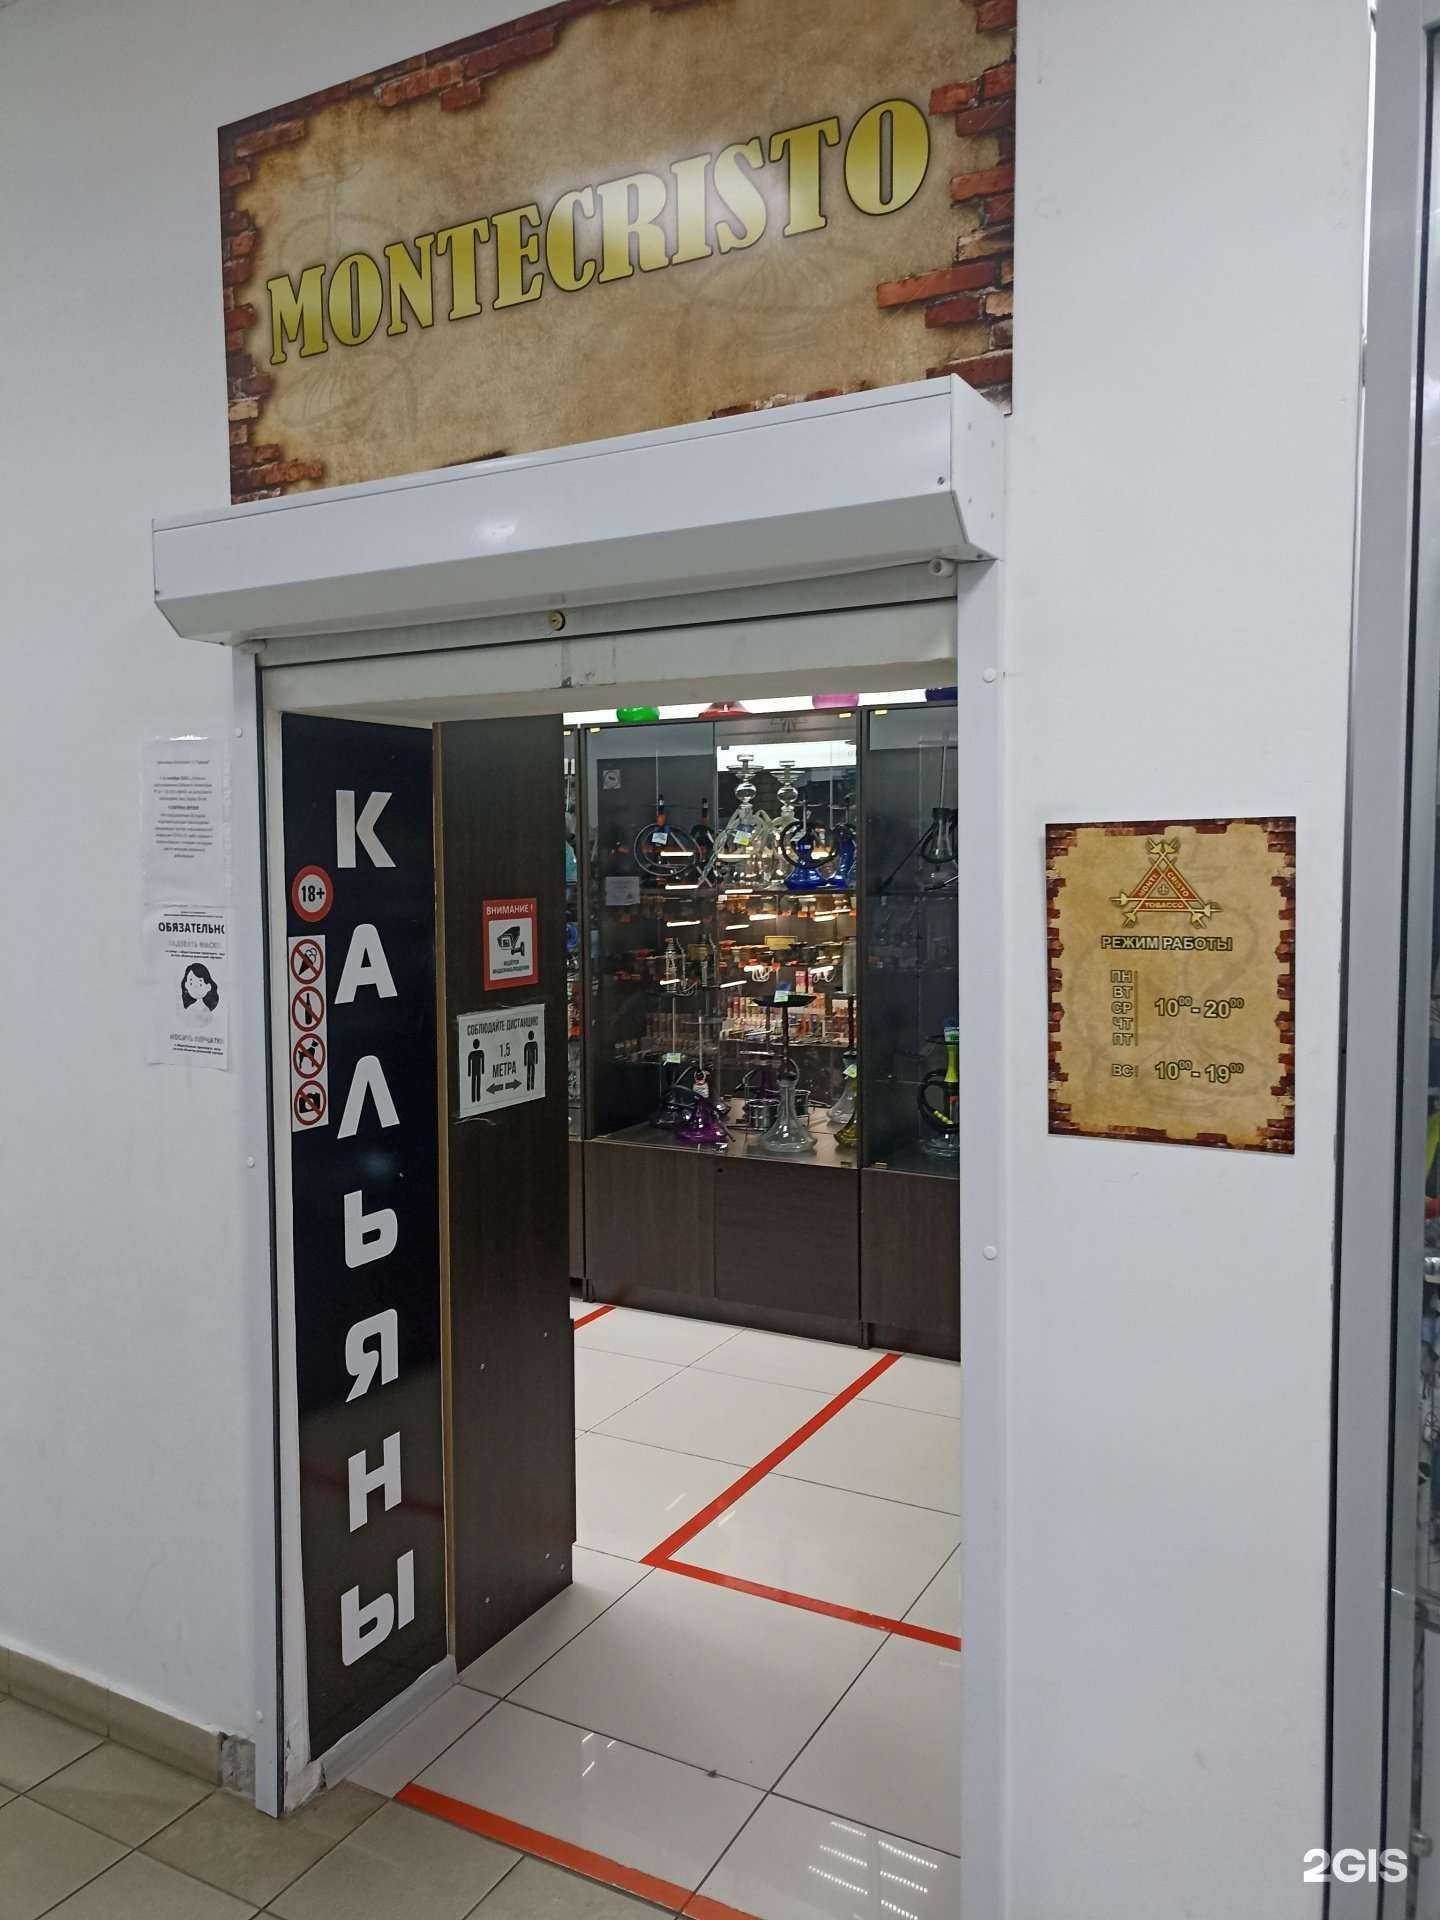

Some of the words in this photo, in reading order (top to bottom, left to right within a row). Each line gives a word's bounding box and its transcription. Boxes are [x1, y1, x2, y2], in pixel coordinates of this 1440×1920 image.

[267, 97, 931, 366] MONTECRISTO
[301, 885, 325, 902] 18+
[486, 904, 529, 916] ВНИМАНИЕ
[1101, 936, 1160, 951] РЕЖИМ
[1161, 936, 1233, 952] РАБОТЫ
[1110, 970, 1133, 983] ПН
[1112, 985, 1133, 999] ВТ
[1110, 1001, 1133, 1015] СР
[1112, 1017, 1134, 1031] ЧТ
[1112, 1032, 1134, 1046] ПТ
[492, 1061, 517, 1078] МЕТРА
[1111, 1064, 1134, 1078] ВС
[334, 789, 415, 1667] КАЛЬЯНЫ
